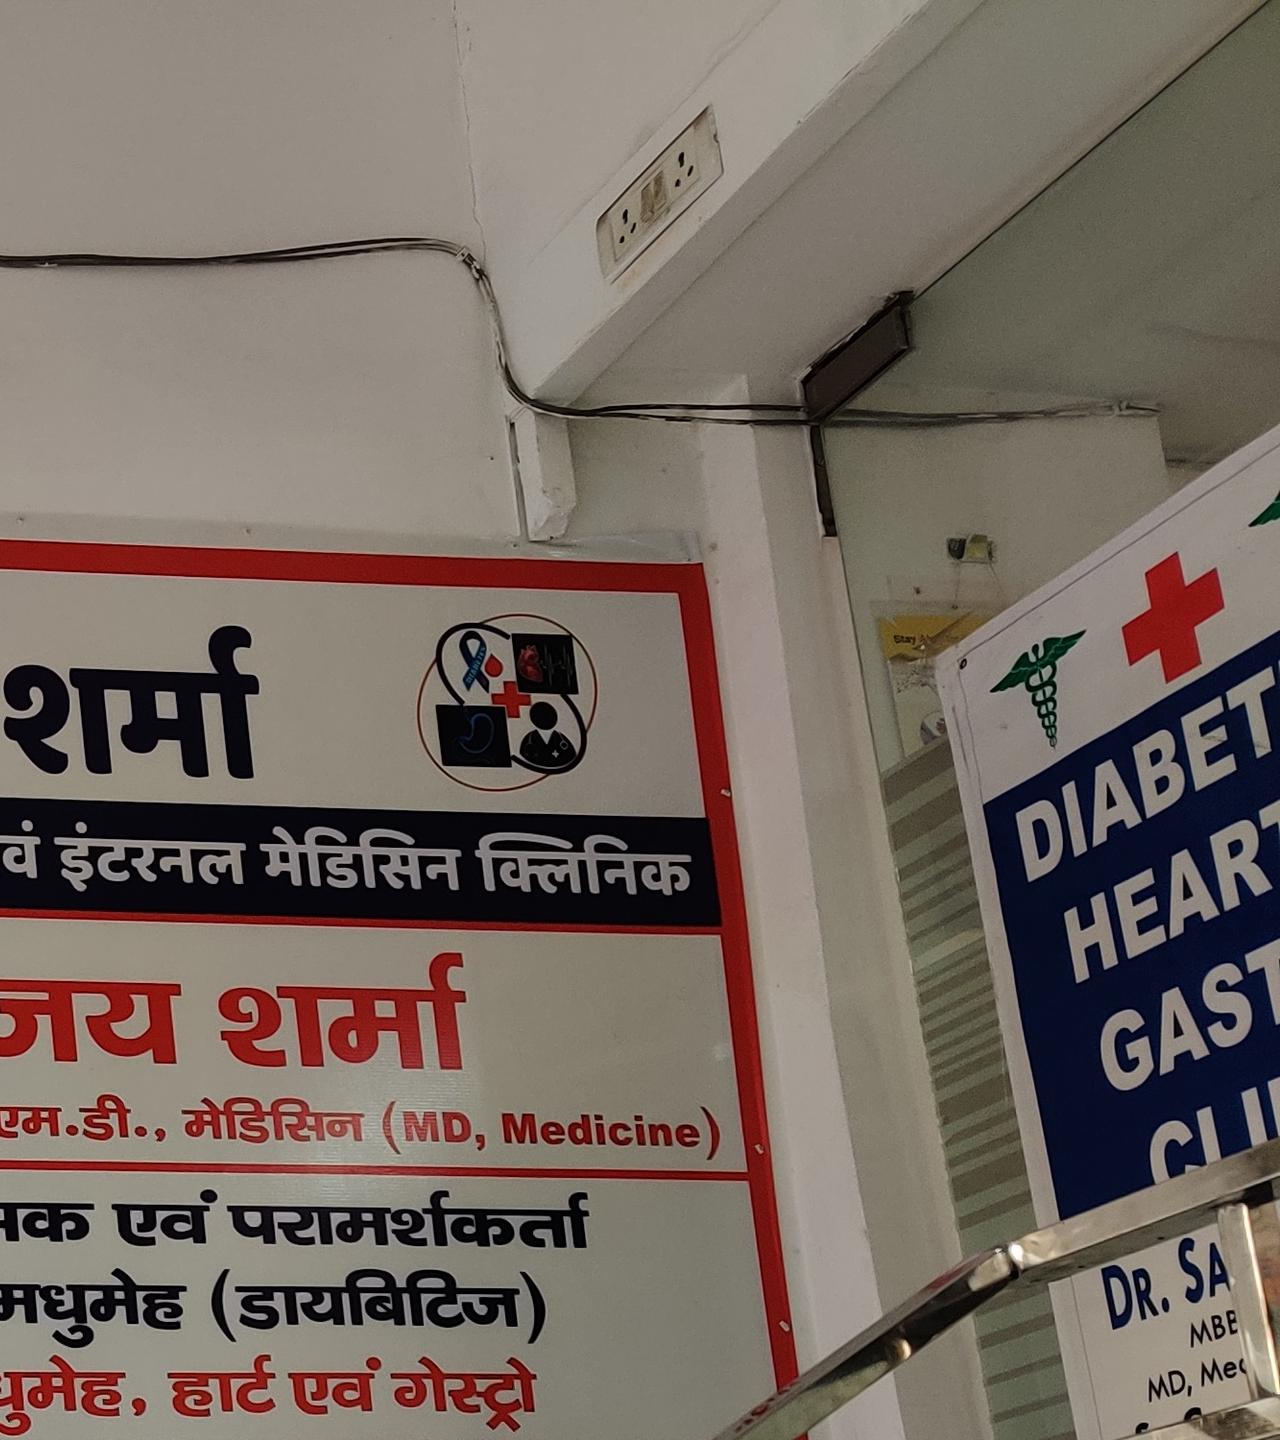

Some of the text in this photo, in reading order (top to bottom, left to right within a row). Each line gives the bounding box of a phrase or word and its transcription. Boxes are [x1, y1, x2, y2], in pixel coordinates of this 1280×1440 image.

[2, 625, 259, 779] शर्मा
[1015, 660, 1280, 883] DIABET
[55, 821, 245, 892] इंटरनल
[259, 827, 461, 891] मेडिसिन
[476, 832, 691, 896] क्लिनिक
[217, 952, 466, 1071] शर्मा
[181, 1097, 364, 1144] मेडिसिन
[382, 1101, 488, 1155] (MD,
[501, 1105, 720, 1160] Medicine)
[1150, 1076, 1280, 1185] CLI
[112, 1189, 217, 1246] एवं
[227, 1190, 590, 1249] परामर्शकर्ता
[211, 1268, 546, 1344] (डायबिटिज)
[1101, 1264, 1170, 1330] DR.
[169, 1355, 276, 1418] हार्ट
[290, 1357, 383, 1414] एवं
[390, 1356, 538, 1431] गेस्ट्रो
[1148, 1370, 1193, 1403] MD,
